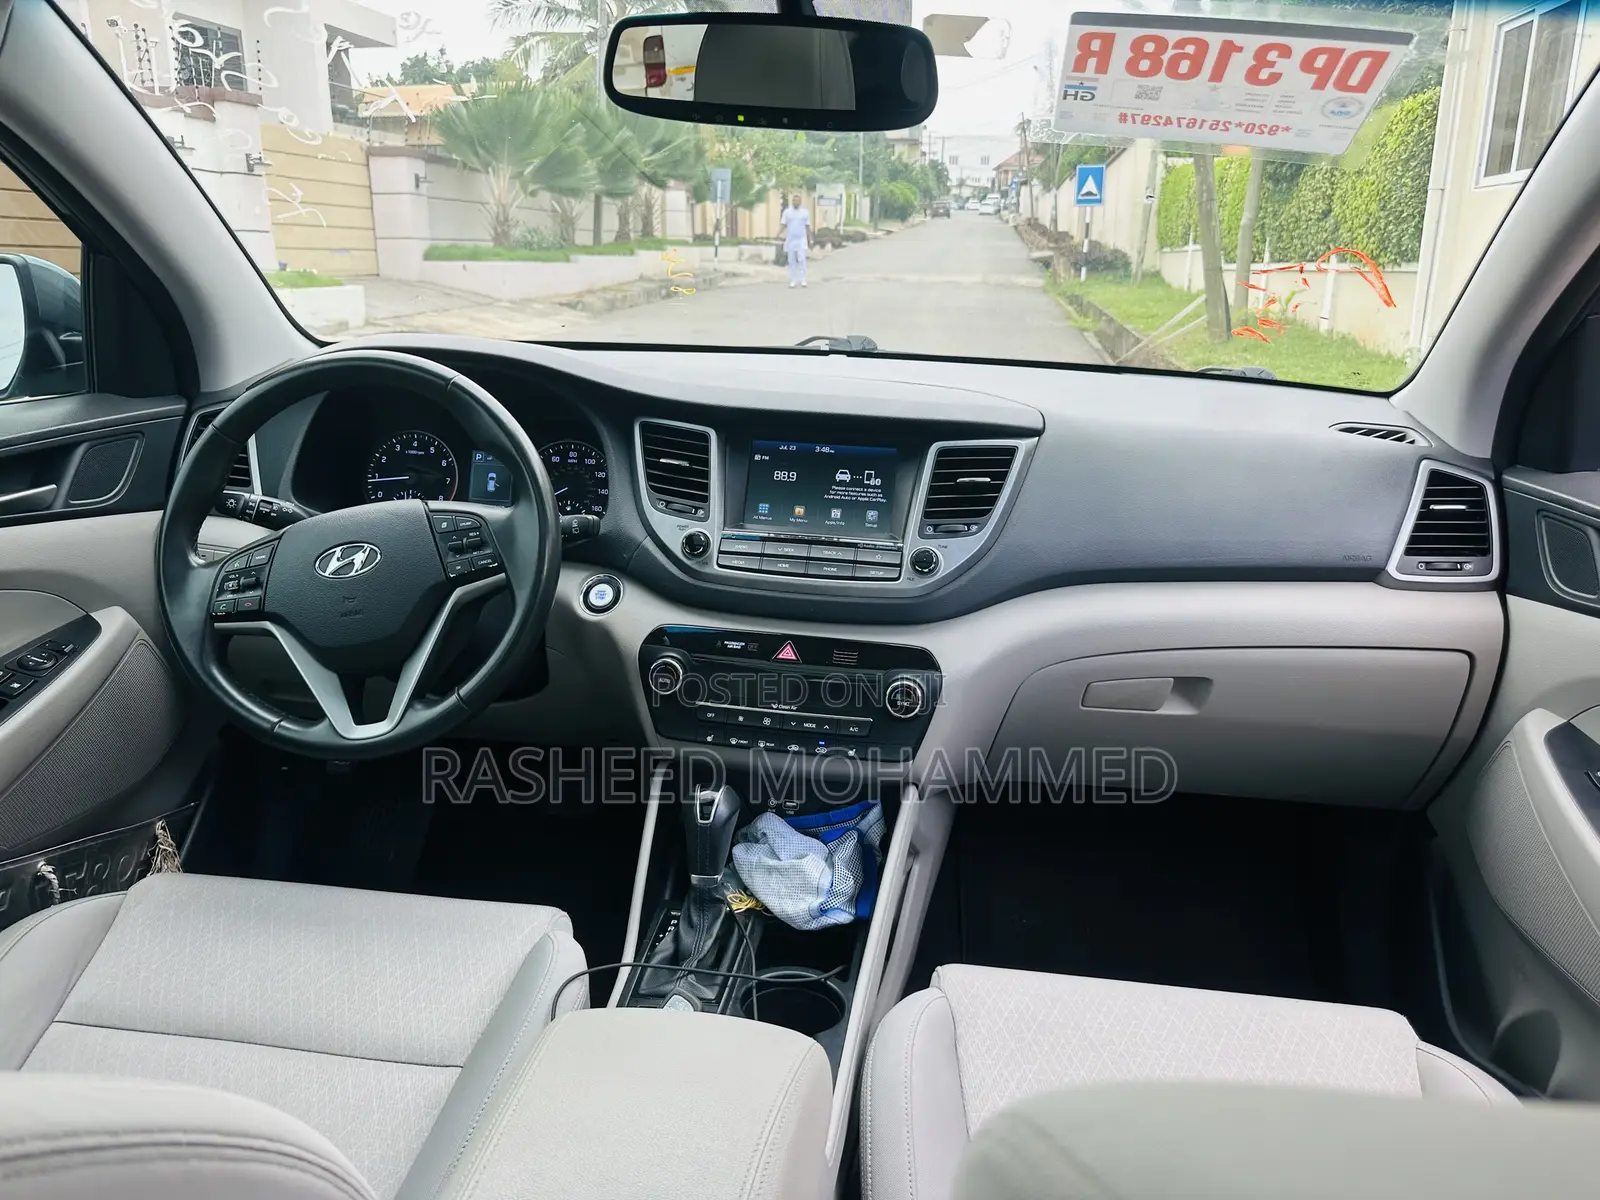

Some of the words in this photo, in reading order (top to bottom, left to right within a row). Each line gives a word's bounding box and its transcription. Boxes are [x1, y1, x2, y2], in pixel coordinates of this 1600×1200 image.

[430, 446, 435, 454] 5
[475, 453, 482, 461] P
[773, 470, 797, 482] 88.9
